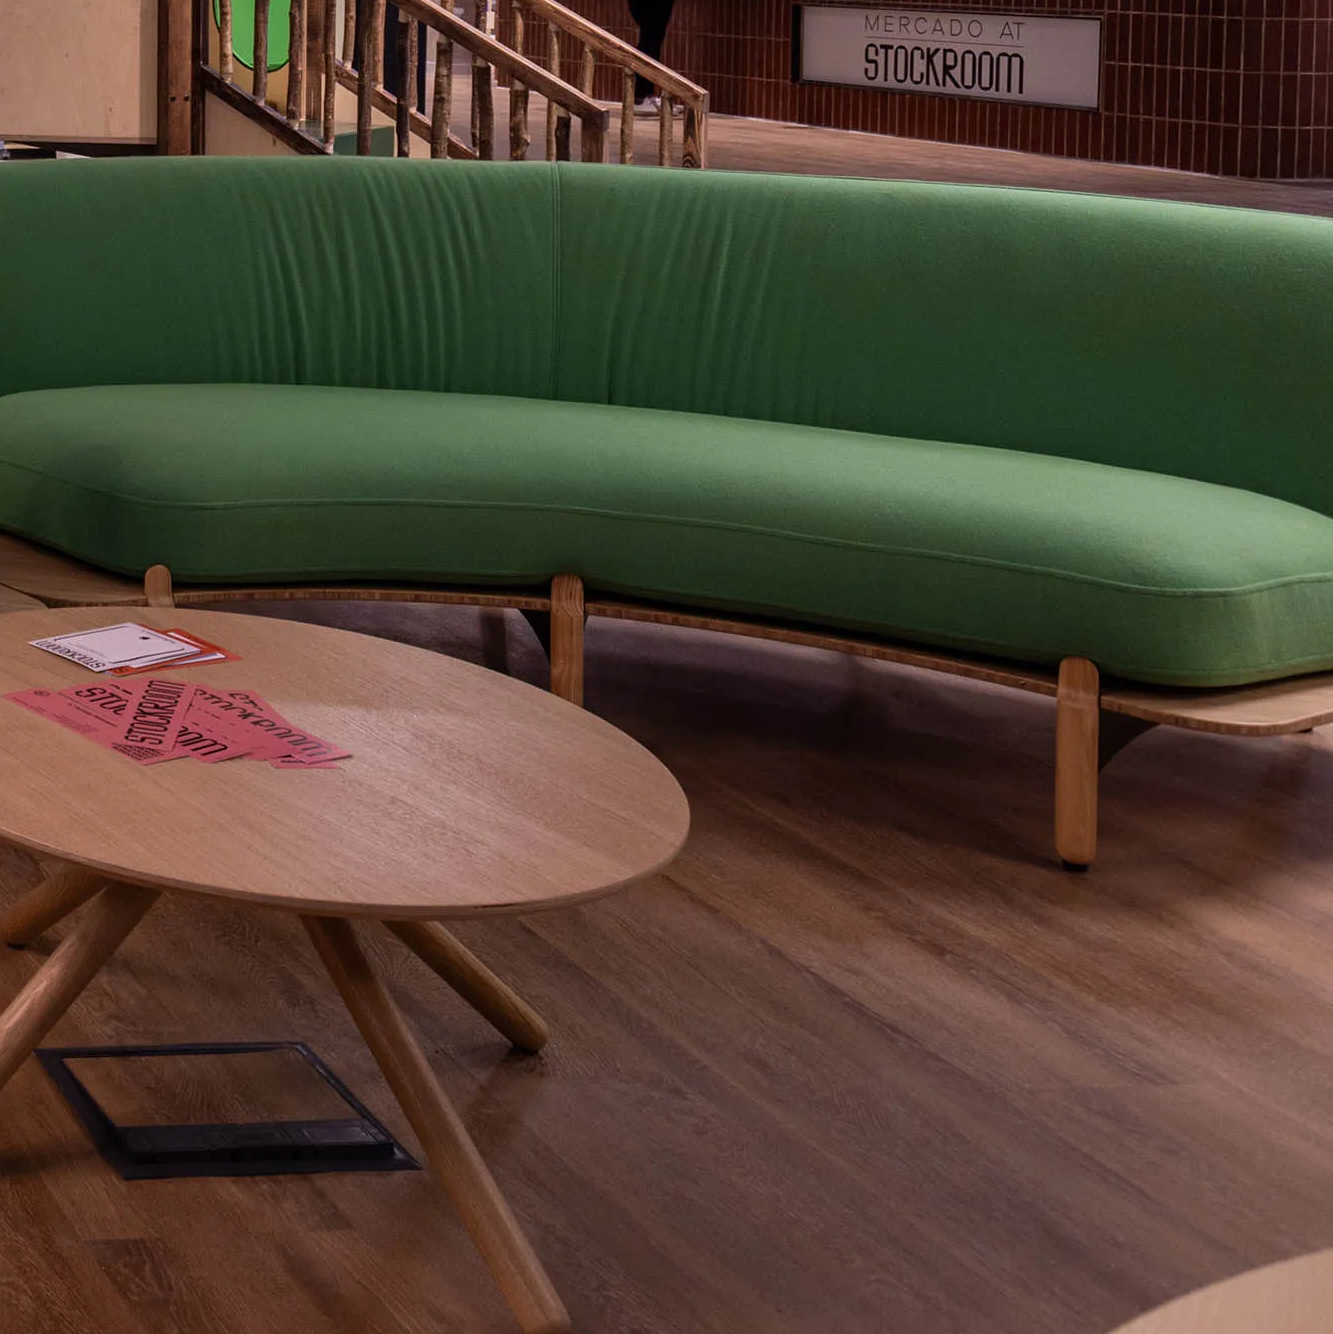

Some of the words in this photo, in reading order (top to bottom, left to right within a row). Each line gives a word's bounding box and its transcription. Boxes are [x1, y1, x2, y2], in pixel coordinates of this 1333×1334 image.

[864, 14, 984, 39] MERCADO
[999, 21, 1027, 41] AT
[864, 44, 1024, 94] STOCKROOM
[124, 679, 187, 746] STOCKROOM
